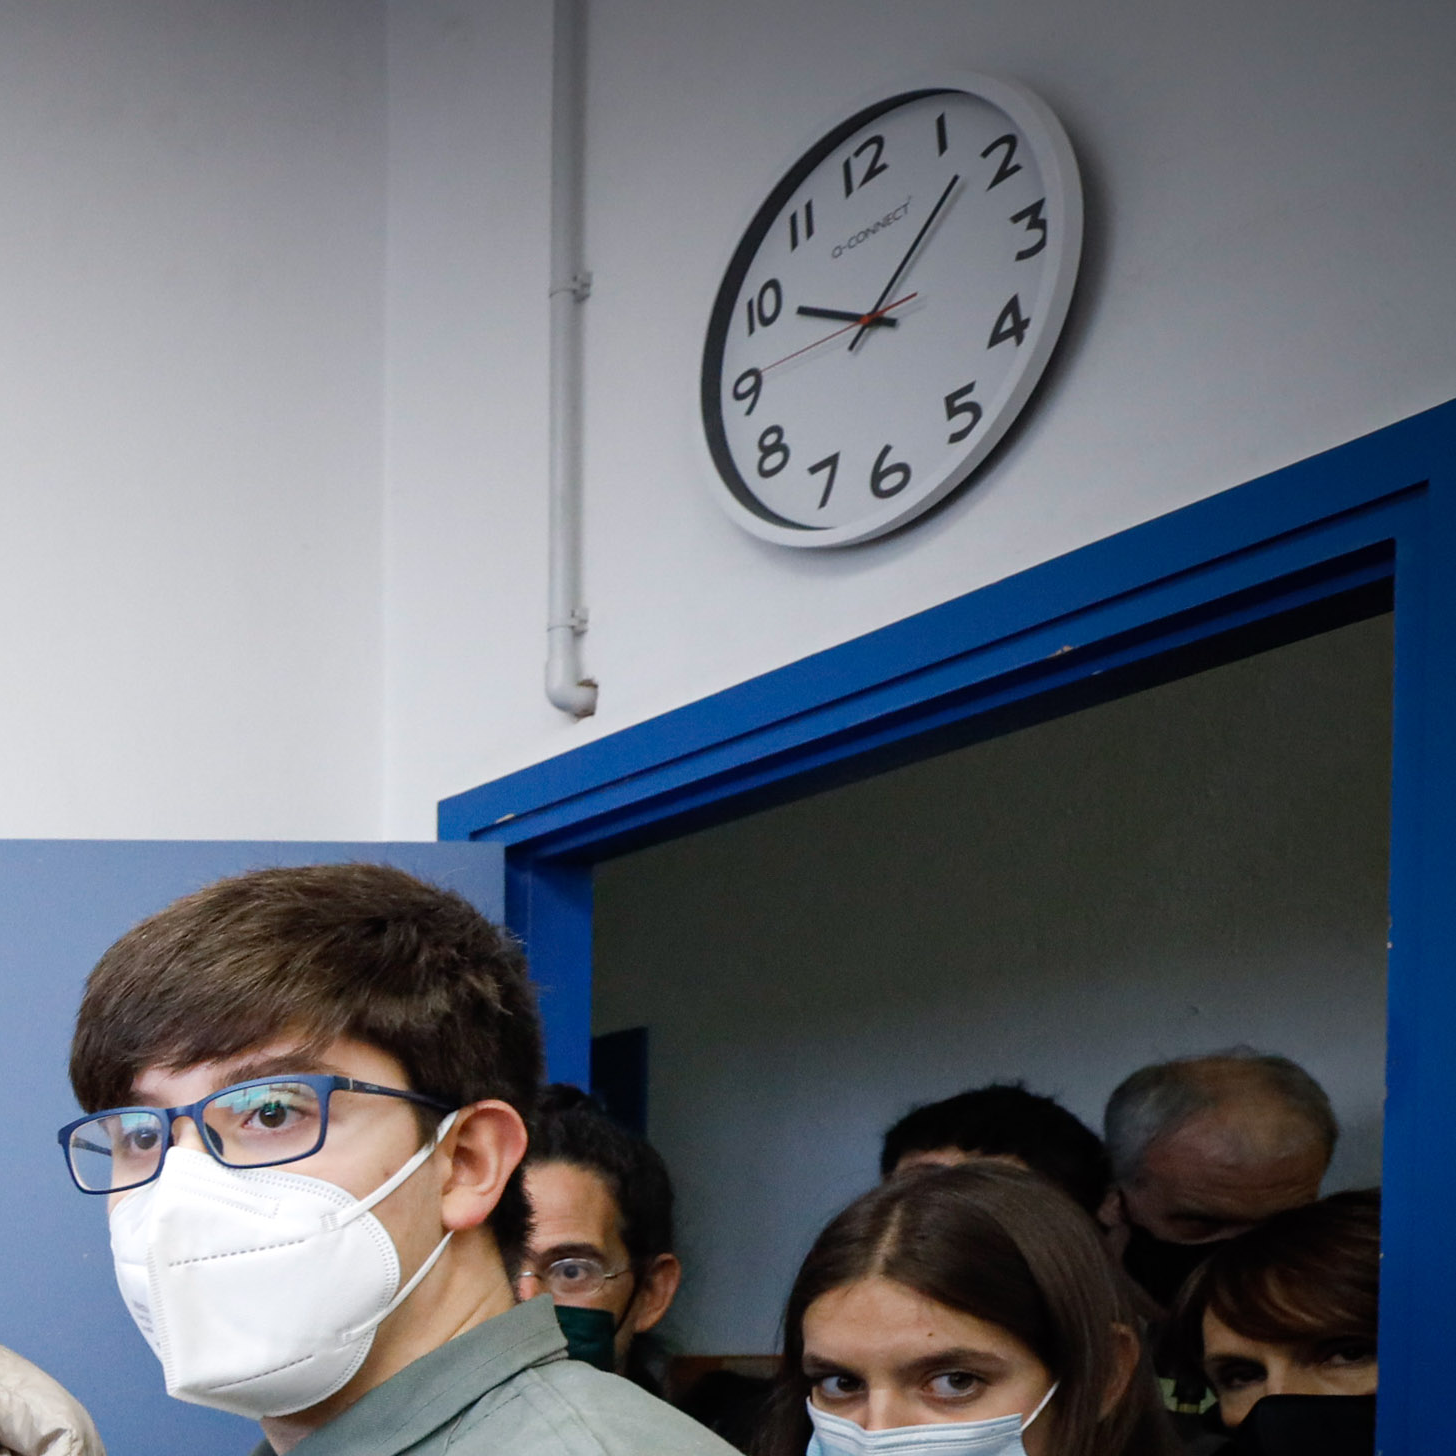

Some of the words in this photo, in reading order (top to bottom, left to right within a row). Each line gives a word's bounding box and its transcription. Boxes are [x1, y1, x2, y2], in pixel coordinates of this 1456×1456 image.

[935, 112, 948, 157] 1
[980, 133, 1023, 191] 2
[841, 134, 890, 199] 12
[787, 200, 815, 253] 11
[1010, 197, 1047, 262] 3
[745, 278, 782, 337] 10
[987, 292, 1031, 350] 4
[732, 367, 763, 416] 9
[943, 380, 983, 445] 5
[757, 424, 791, 479] 8
[807, 451, 840, 510] 7
[870, 444, 912, 500] 6
